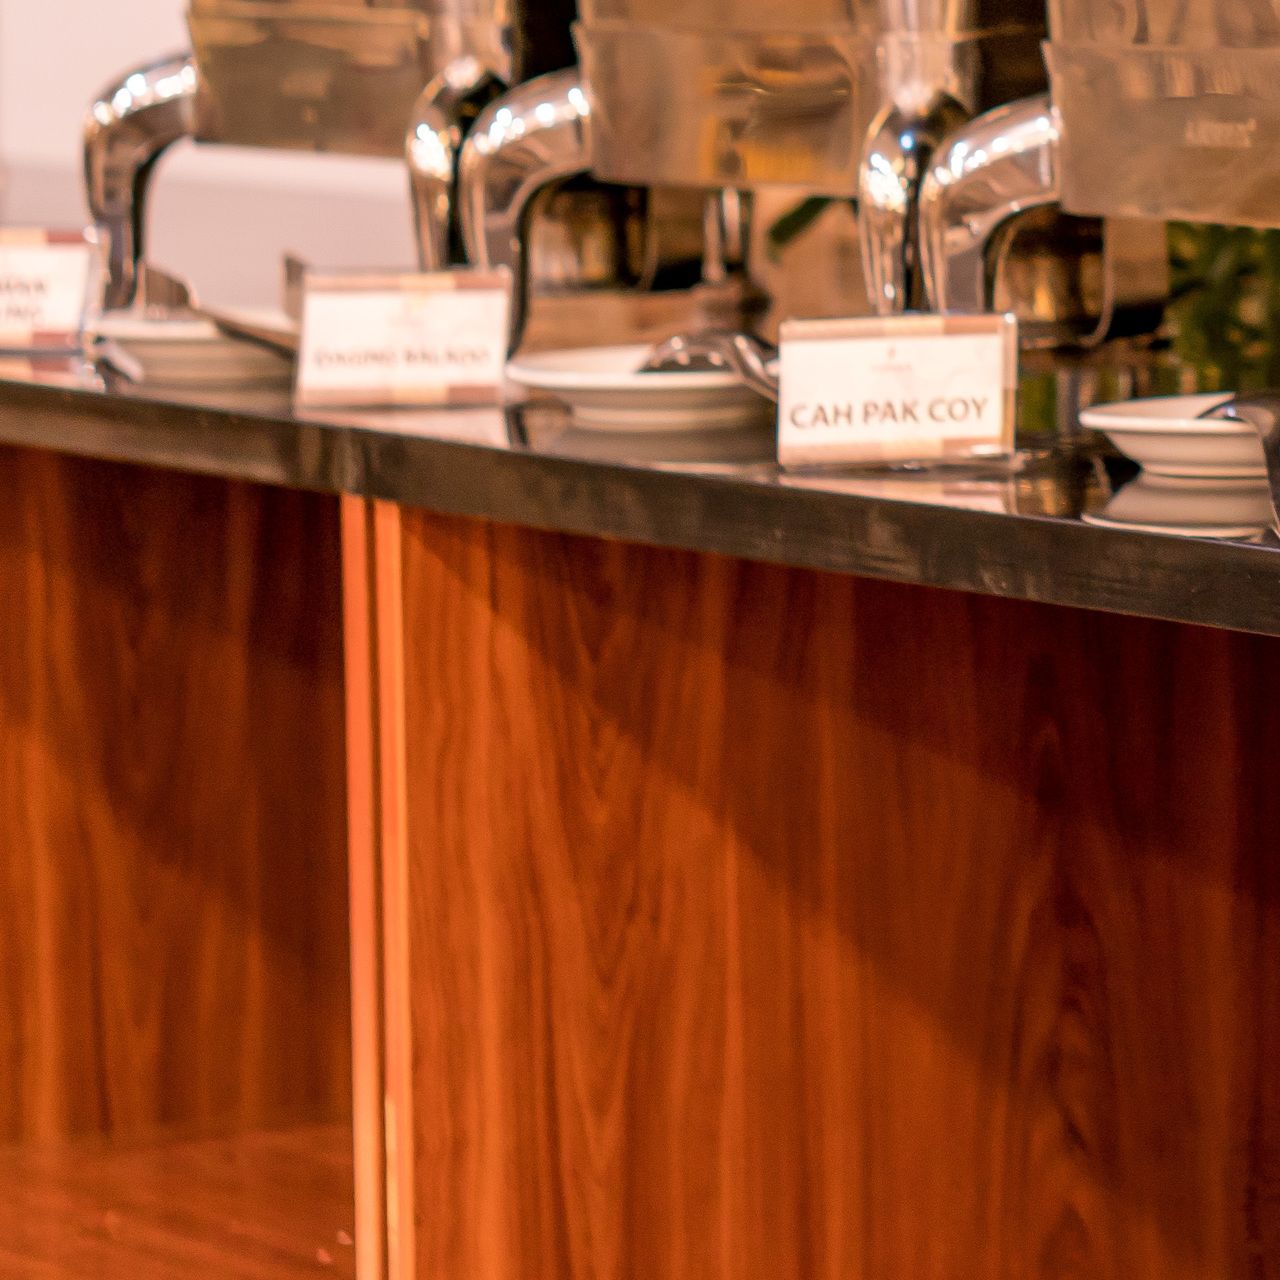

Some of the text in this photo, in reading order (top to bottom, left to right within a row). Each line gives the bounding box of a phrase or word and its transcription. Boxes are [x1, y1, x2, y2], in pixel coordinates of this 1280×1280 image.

[788, 396, 989, 429] CAH PAK COY
